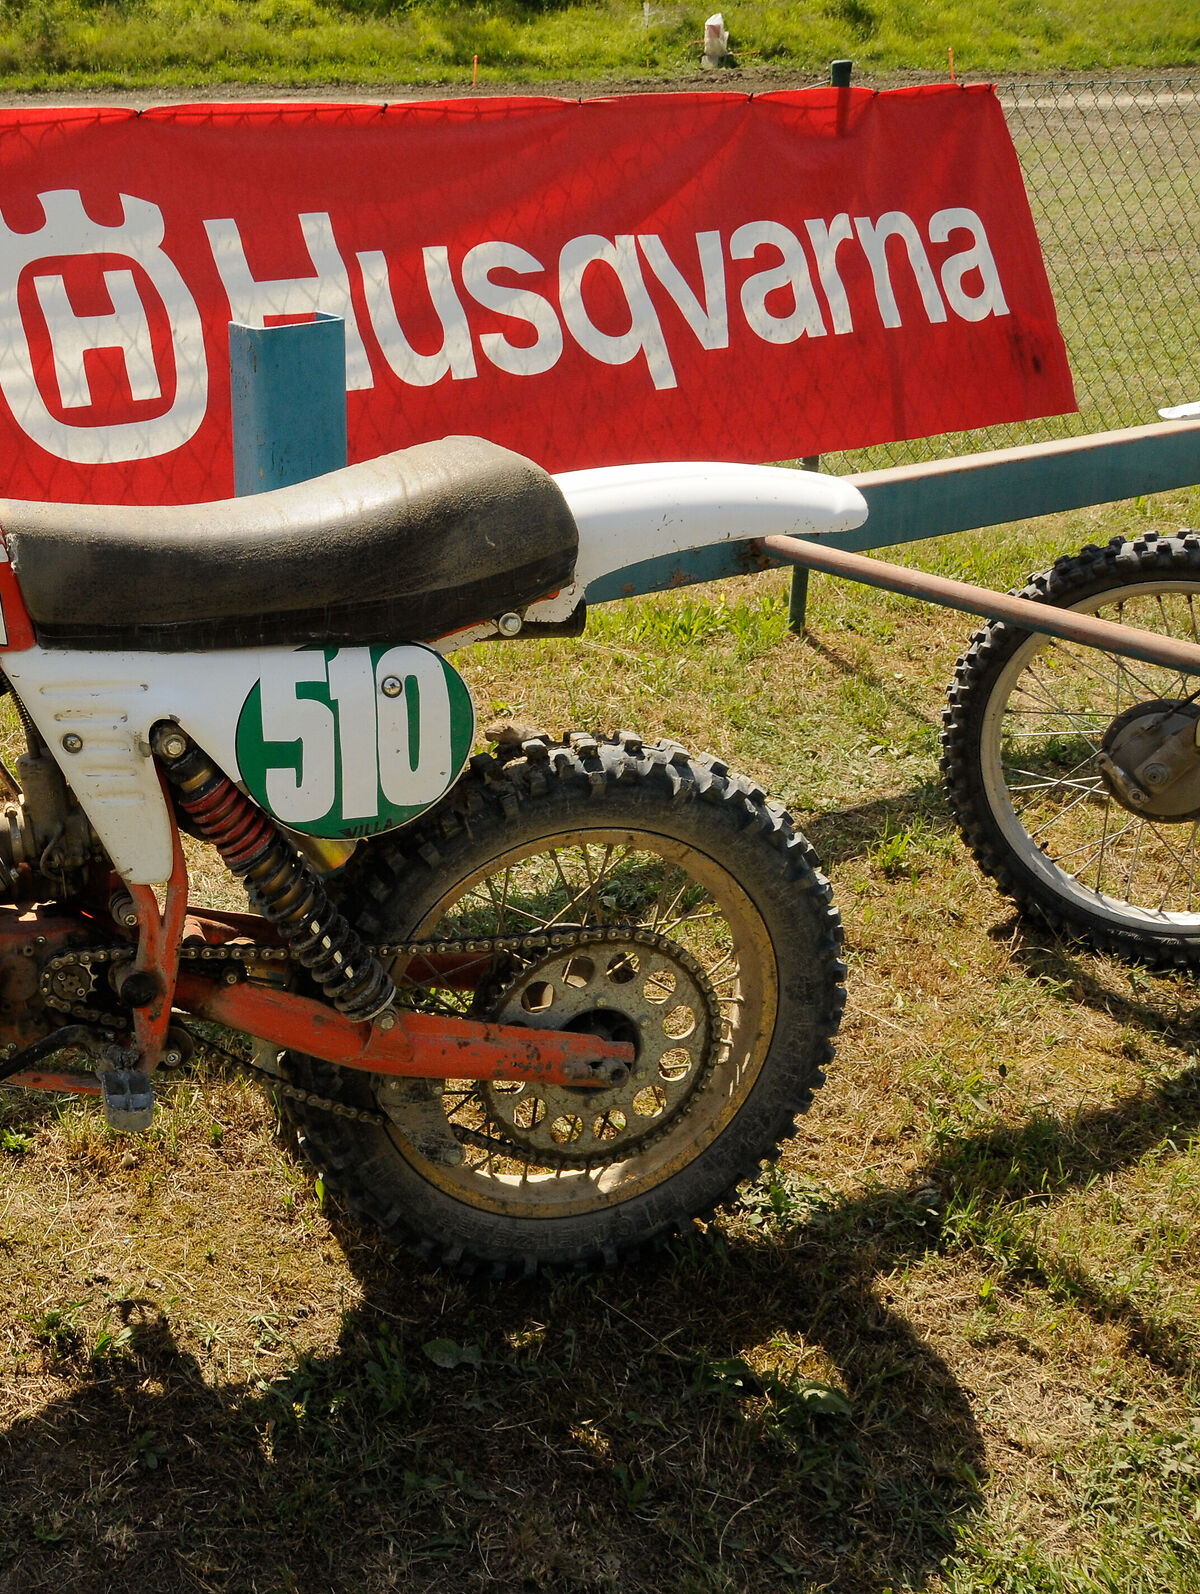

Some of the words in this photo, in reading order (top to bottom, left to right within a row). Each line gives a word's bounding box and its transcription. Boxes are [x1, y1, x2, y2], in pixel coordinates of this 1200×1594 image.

[203, 206, 1011, 390] Husqvarna
[259, 645, 452, 823] 510
[340, 818, 394, 838] VILLA
